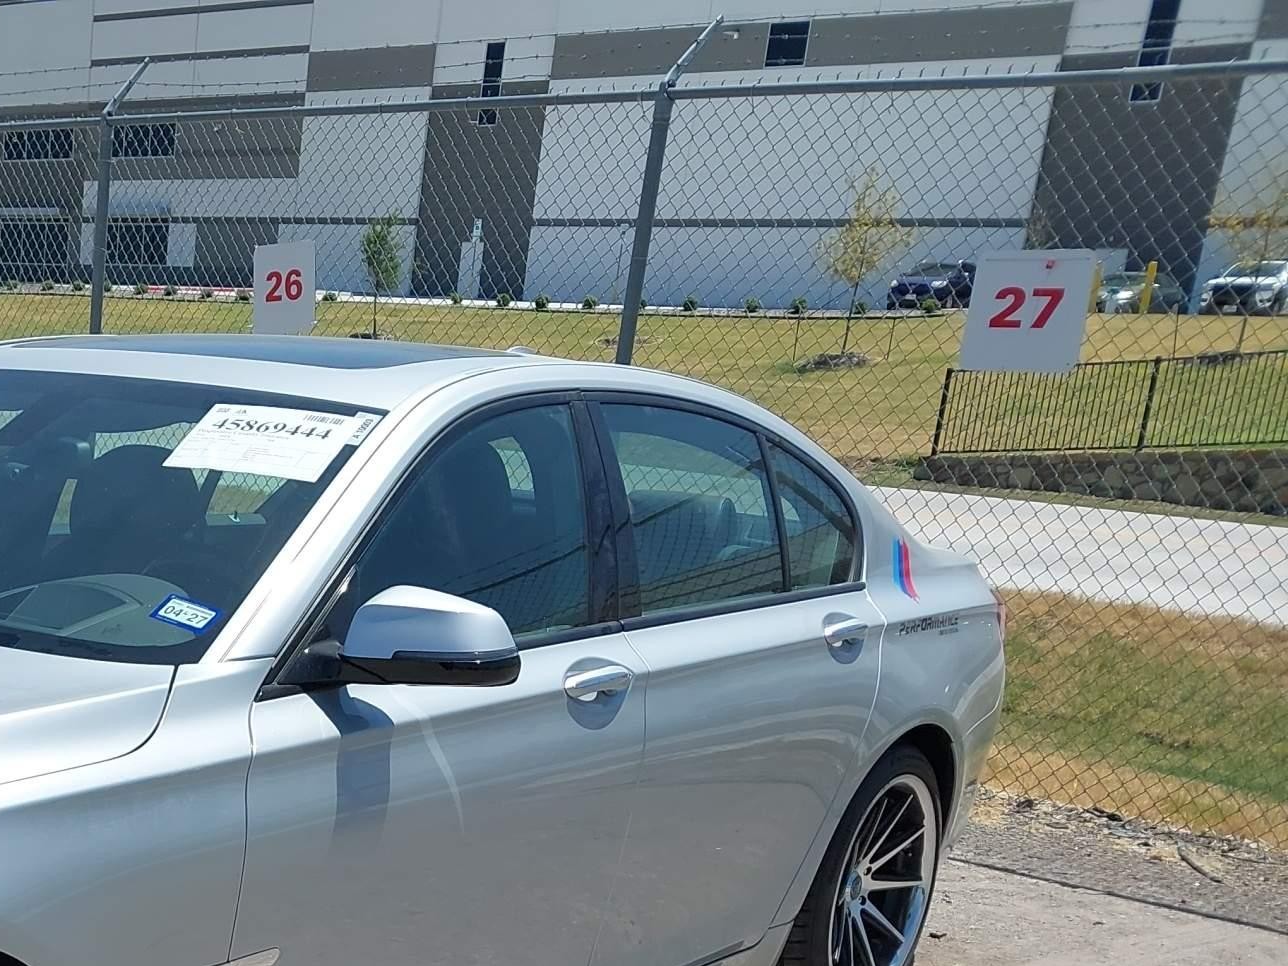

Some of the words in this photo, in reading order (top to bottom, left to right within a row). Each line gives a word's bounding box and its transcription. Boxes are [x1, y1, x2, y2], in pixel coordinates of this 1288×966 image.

[265, 269, 303, 302] 26
[989, 286, 1065, 328] 27
[212, 417, 332, 440] 45869444
